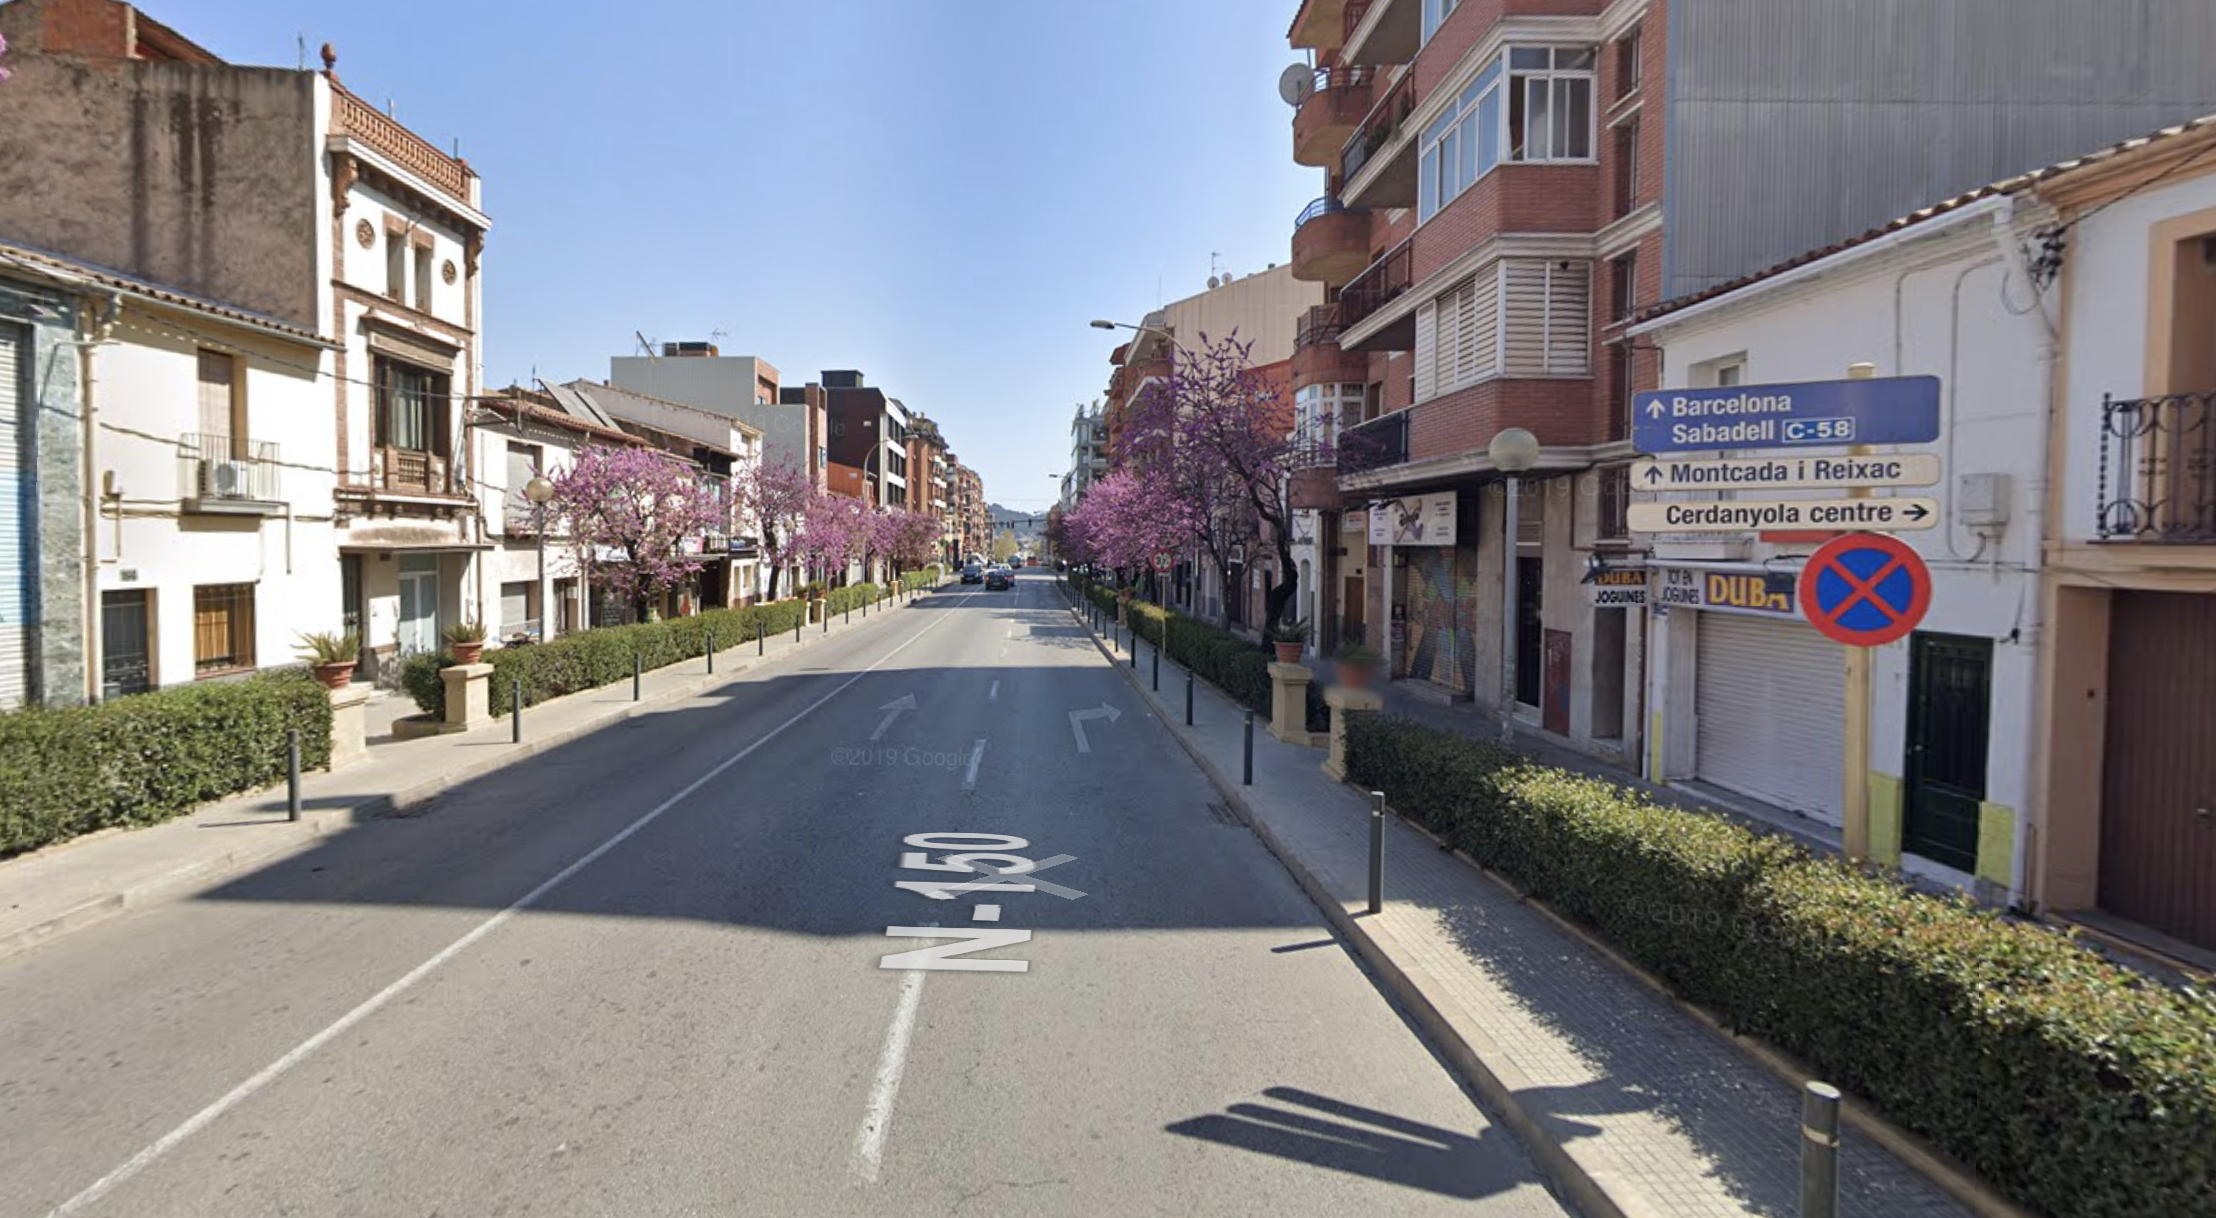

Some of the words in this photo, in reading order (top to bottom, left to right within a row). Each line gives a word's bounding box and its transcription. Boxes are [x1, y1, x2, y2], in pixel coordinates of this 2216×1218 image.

[1672, 393, 1792, 417] Barcelona
[1672, 419, 1774, 444] Sabadell
[1786, 421, 1850, 440] C-58
[1670, 461, 1788, 483] Montcada
[1797, 460, 1805, 481] i
[1814, 458, 1901, 481] Reixac
[1666, 504, 1800, 528] Cerdanyola
[1810, 503, 1893, 523] centre
[1594, 590, 1646, 604] JOGUINES
